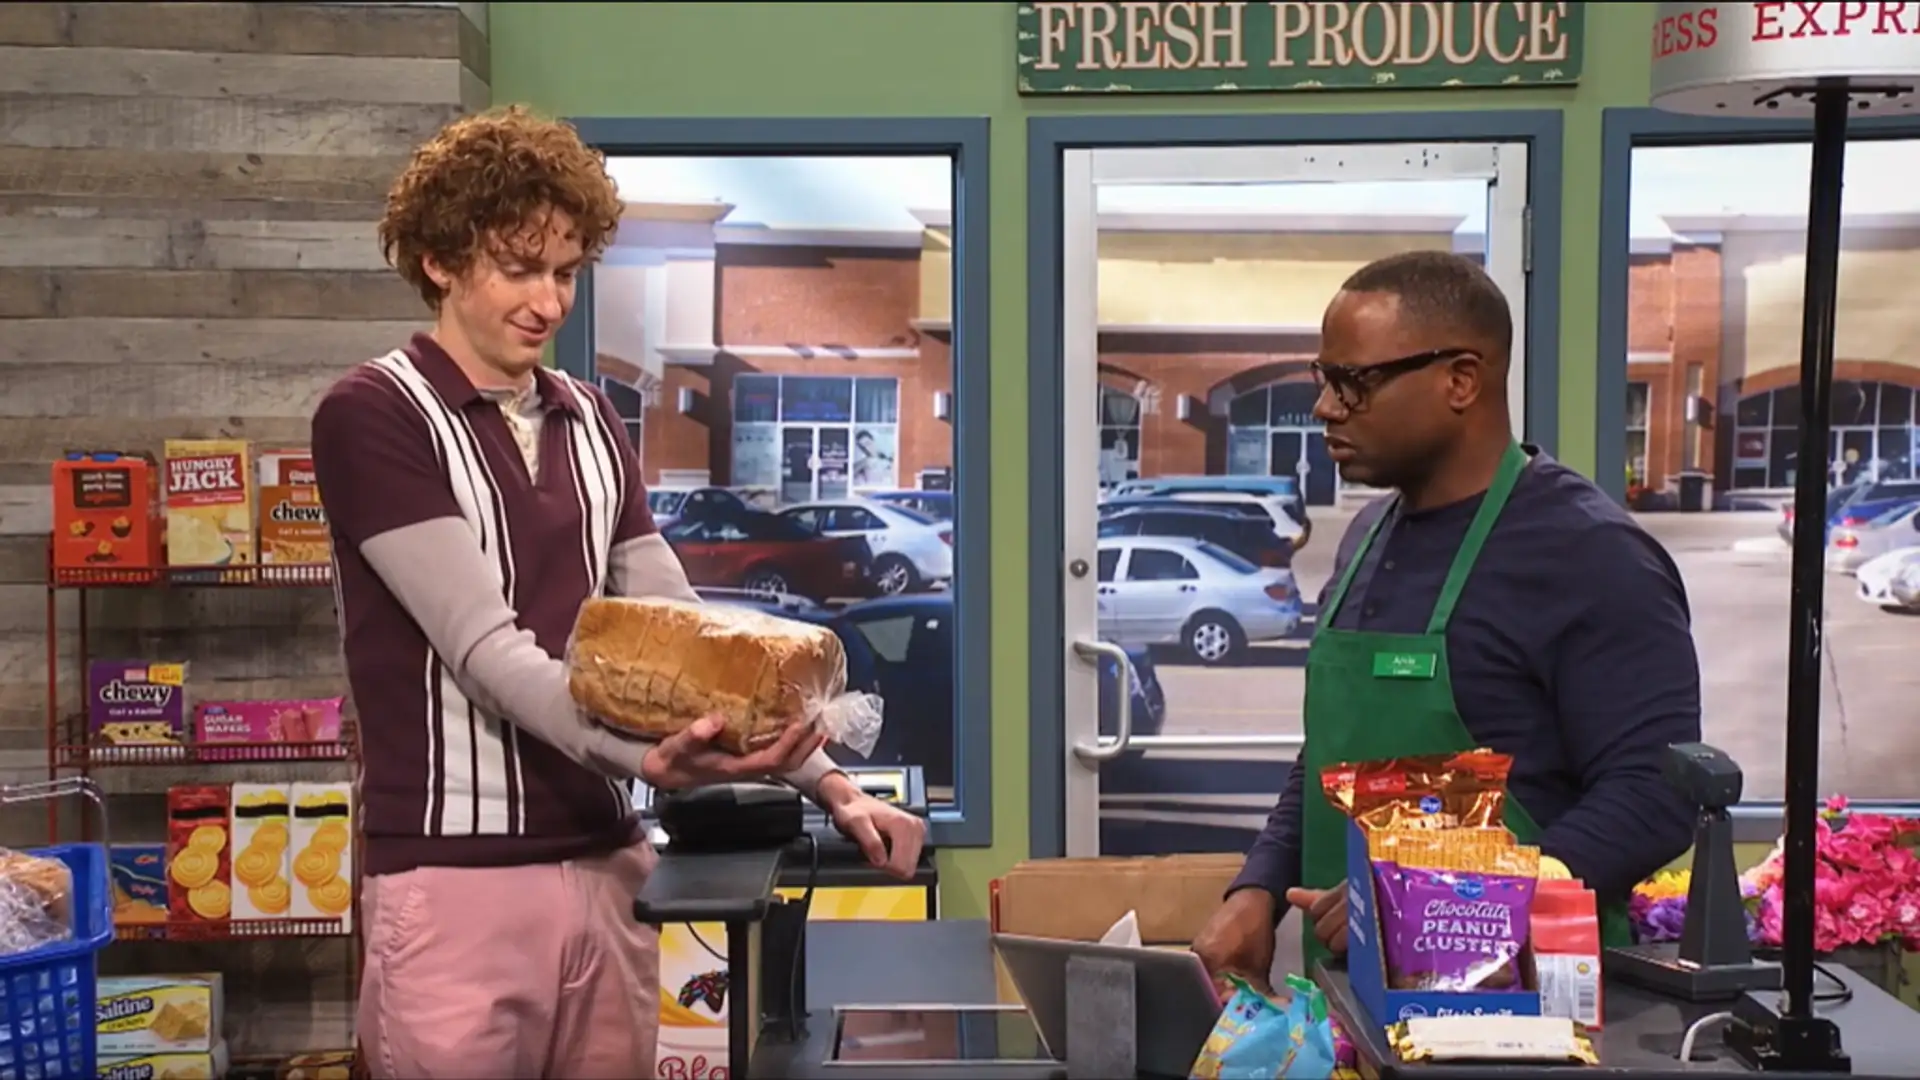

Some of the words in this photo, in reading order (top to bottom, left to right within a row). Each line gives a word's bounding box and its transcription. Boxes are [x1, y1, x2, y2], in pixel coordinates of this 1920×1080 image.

[1034, 2, 1248, 71] FRESH
[1268, 2, 1570, 68] PRODUCE
[170, 456, 235, 473] HUNGRY
[169, 468, 240, 491] JACK
[100, 679, 171, 708] chewy
[204, 723, 252, 733] WAFERS
[1423, 898, 1510, 919] Chocolate
[1422, 917, 1512, 938] PEANUT
